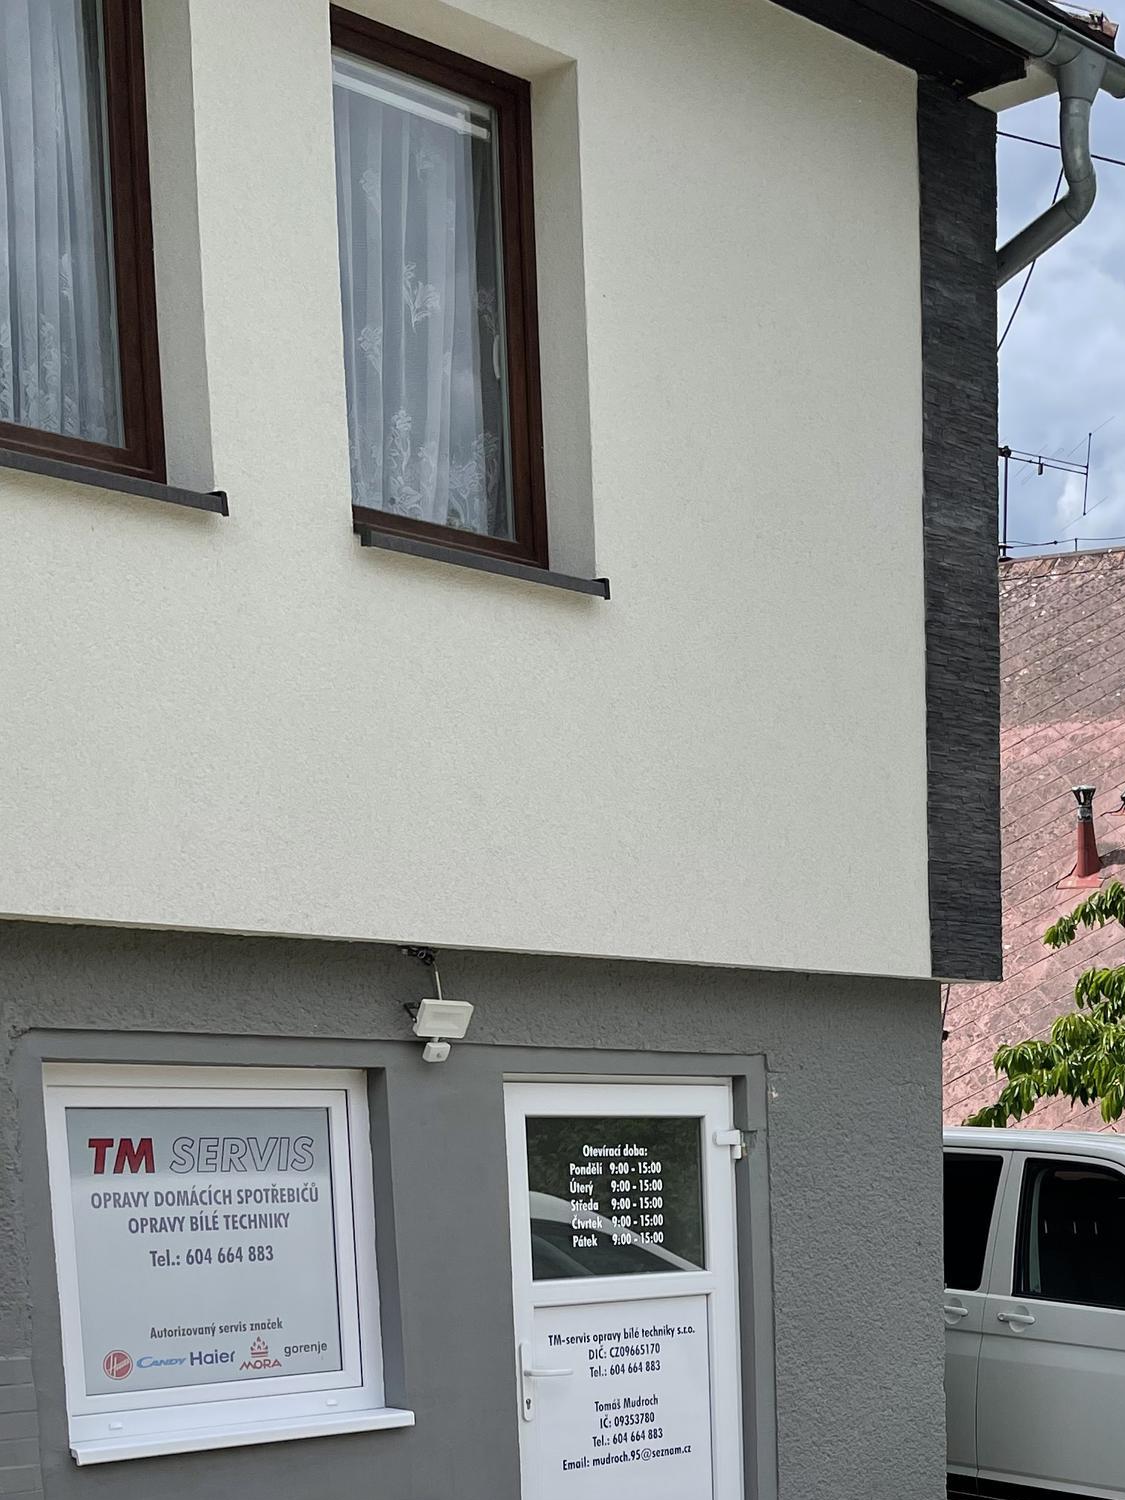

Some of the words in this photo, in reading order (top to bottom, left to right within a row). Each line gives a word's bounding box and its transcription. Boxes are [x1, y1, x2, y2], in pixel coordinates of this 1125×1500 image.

[88, 1138, 156, 1174] TM
[169, 1136, 314, 1174] SERVIS
[583, 1145, 621, 1157] Otevírací
[623, 1144, 648, 1157] doba:
[569, 1162, 603, 1175] Pondělí
[610, 1162, 629, 1175] 9:00
[638, 1162, 662, 1174] 15:00
[91, 1191, 150, 1209] OPRAVY
[154, 1184, 232, 1207] DOMÁCÍCH
[237, 1182, 319, 1205] SPOTŘEBIČŮ
[570, 1178, 594, 1196] Úterý
[611, 1180, 631, 1192] 9:00
[639, 1179, 663, 1192] 15:00
[571, 1199, 599, 1212] Středa
[611, 1198, 631, 1210] 9:00
[640, 1197, 663, 1209] 15:00
[128, 1216, 186, 1234] OPRAVY
[190, 1210, 219, 1232] BÍLÉ
[223, 1213, 290, 1230] TECHNIKY
[572, 1214, 603, 1230] Čtvrtek
[612, 1215, 631, 1228] 9:00
[640, 1214, 664, 1227] 15:00
[573, 1234, 598, 1248] Pátek
[612, 1233, 632, 1246] 9:00
[641, 1232, 664, 1244] 15:00
[150, 1250, 181, 1267] Tel.:
[186, 1249, 212, 1265] 604
[218, 1247, 243, 1264] 664
[248, 1245, 274, 1262] 883
[150, 1322, 216, 1339] Autorizovaný
[219, 1320, 247, 1334] servis
[250, 1317, 283, 1332] značek
[548, 1333, 591, 1346] TM-servis
[593, 1332, 621, 1344] opravy
[624, 1327, 640, 1340] bílé
[642, 1325, 675, 1338] techniky
[677, 1326, 696, 1335] s.r.o.
[190, 1350, 237, 1367] Haier
[284, 1342, 328, 1358] gorenje
[589, 1345, 607, 1360] DIČ:
[610, 1343, 661, 1358] CZ09665170
[239, 1359, 283, 1371] MORA
[590, 1366, 607, 1378] Tel.:
[610, 1364, 625, 1376] 604
[628, 1362, 643, 1374] 664
[646, 1360, 661, 1371] 883
[595, 1399, 621, 1412] Tomáš
[624, 1394, 659, 1409] Mudroch
[600, 1414, 612, 1429] IČ:
[614, 1412, 655, 1427] 09353780
[592, 1435, 610, 1448] Tel.:
[613, 1432, 628, 1445] 604
[631, 1430, 646, 1442] 664
[648, 1428, 663, 1439] 883
[563, 1456, 590, 1471] Email:
[593, 1445, 692, 1467] mudroch.95@seznam.cz
